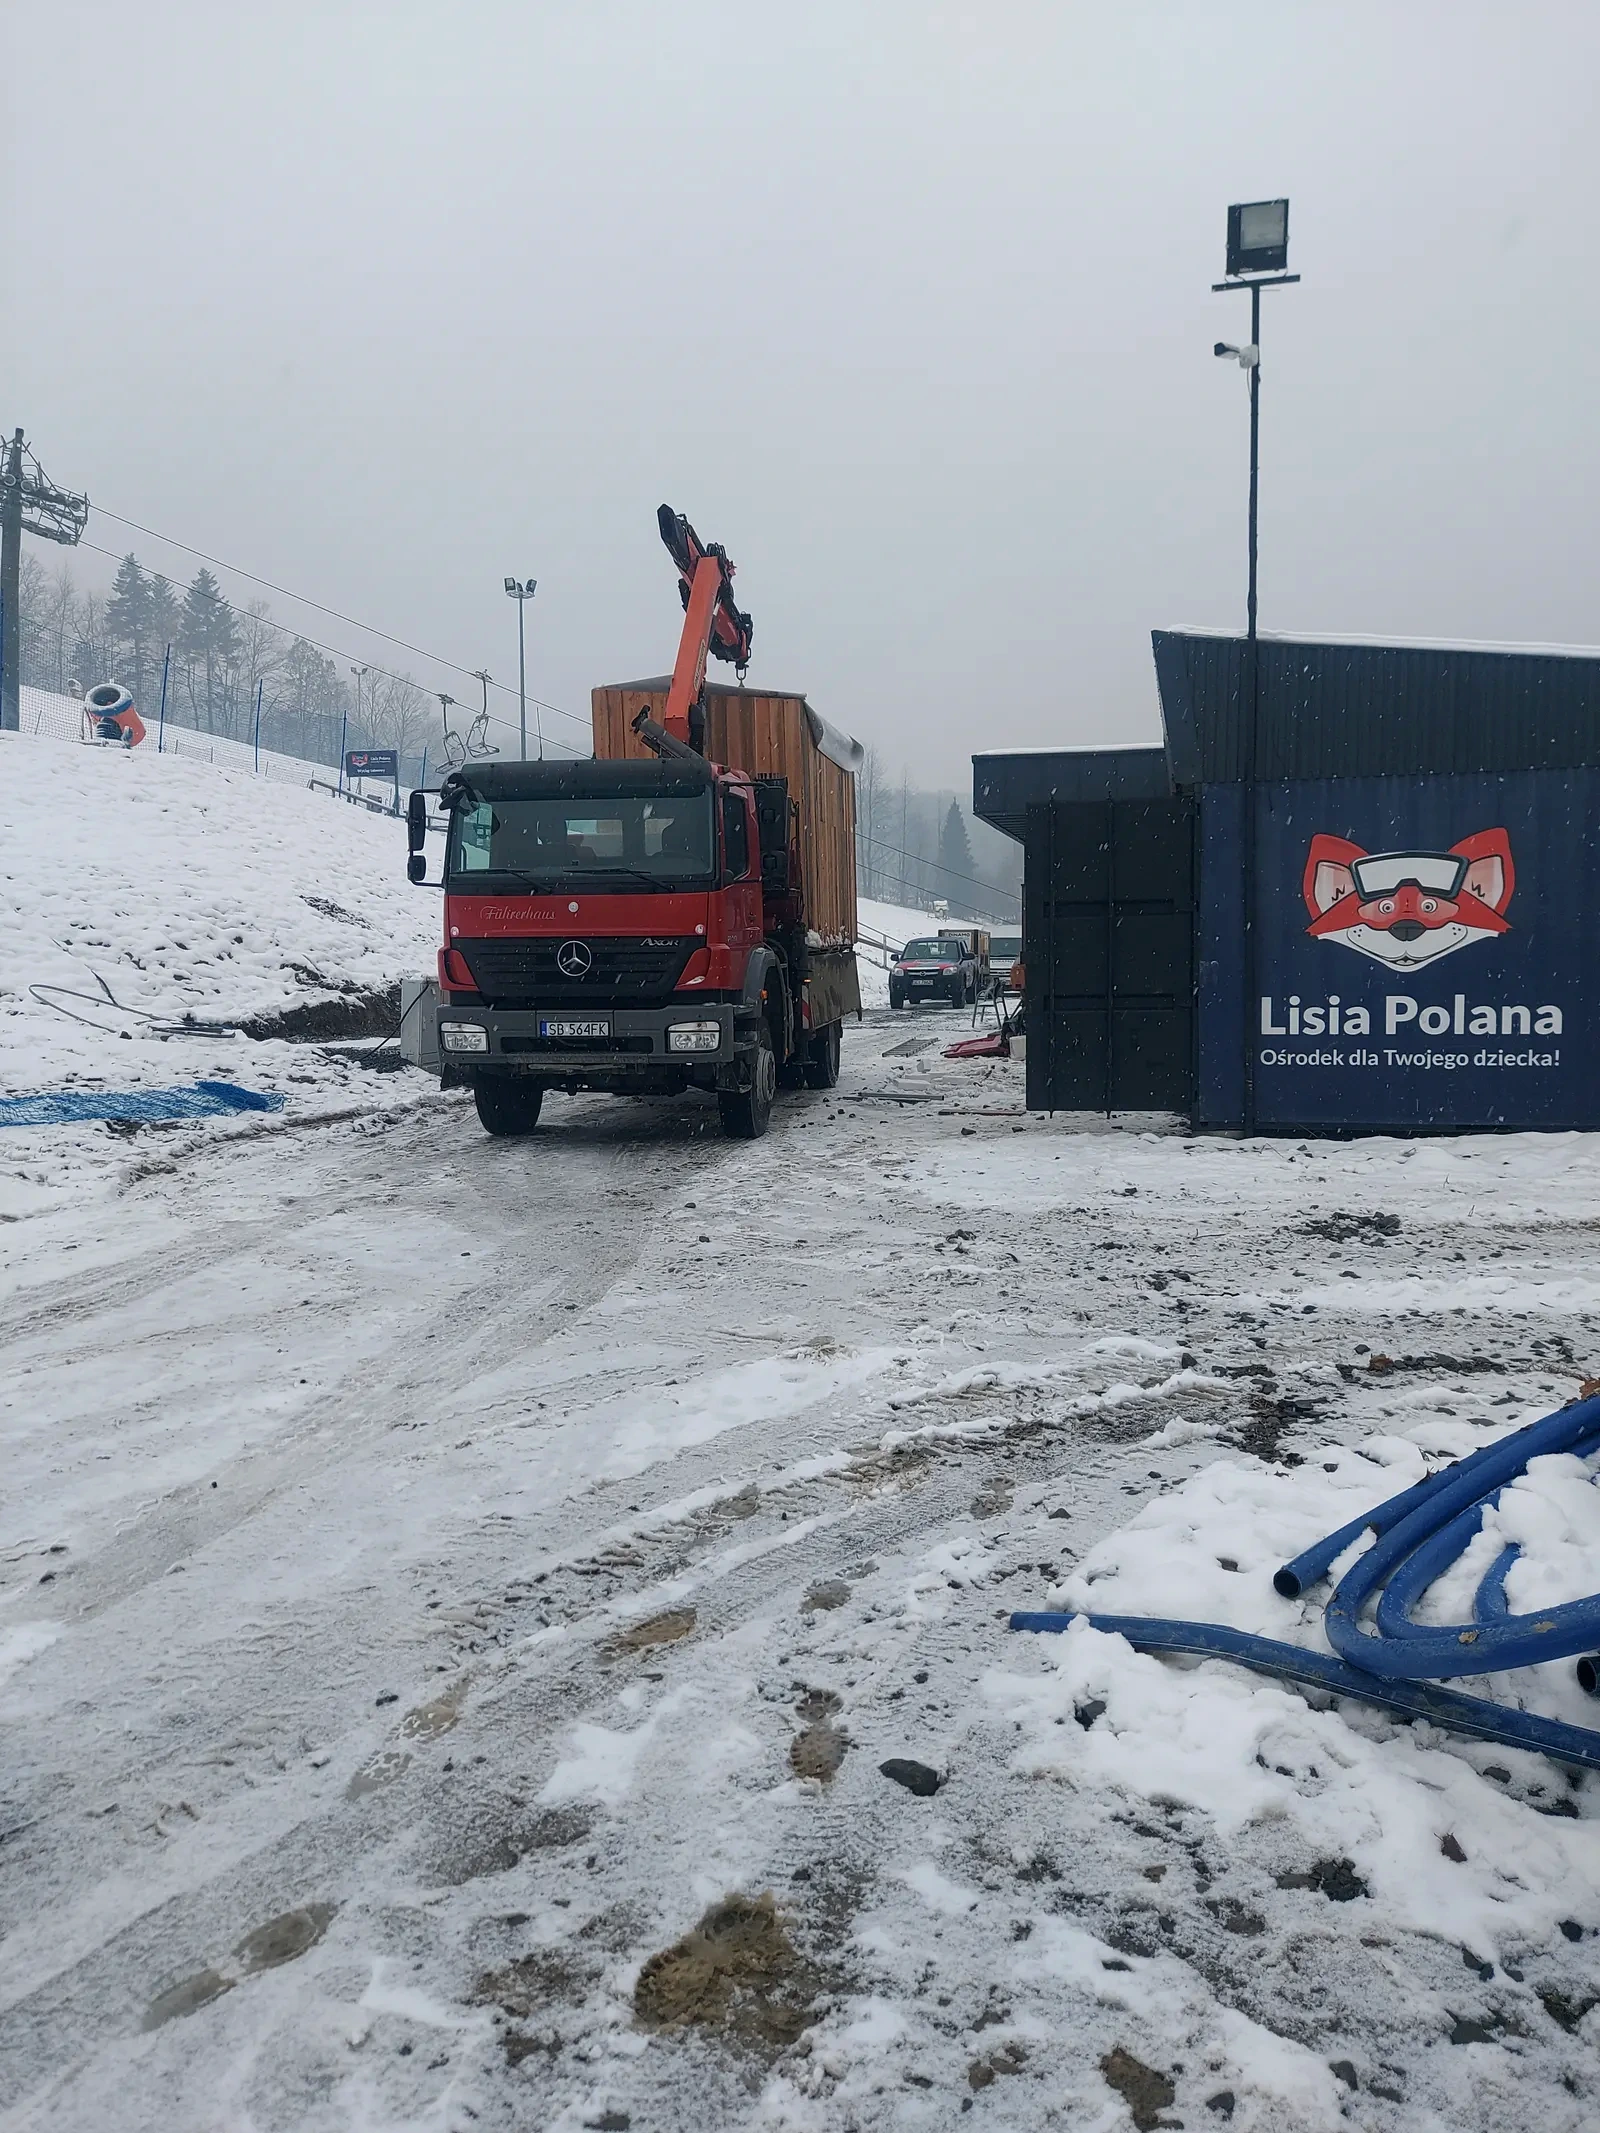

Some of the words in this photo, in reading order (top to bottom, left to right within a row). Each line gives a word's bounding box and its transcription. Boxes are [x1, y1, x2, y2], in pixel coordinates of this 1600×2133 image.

[480, 905, 556, 920] Führerhaus
[1260, 995, 1370, 1036] Lisia
[1385, 994, 1564, 1036] Polana
[548, 1023, 564, 1036] SB
[569, 1023, 606, 1036] 564FK
[1259, 1048, 1345, 1067] Ośrodek
[1348, 1049, 1379, 1066] dla
[1383, 1049, 1469, 1070] Twojego
[1473, 1049, 1560, 1067] dziecka!
